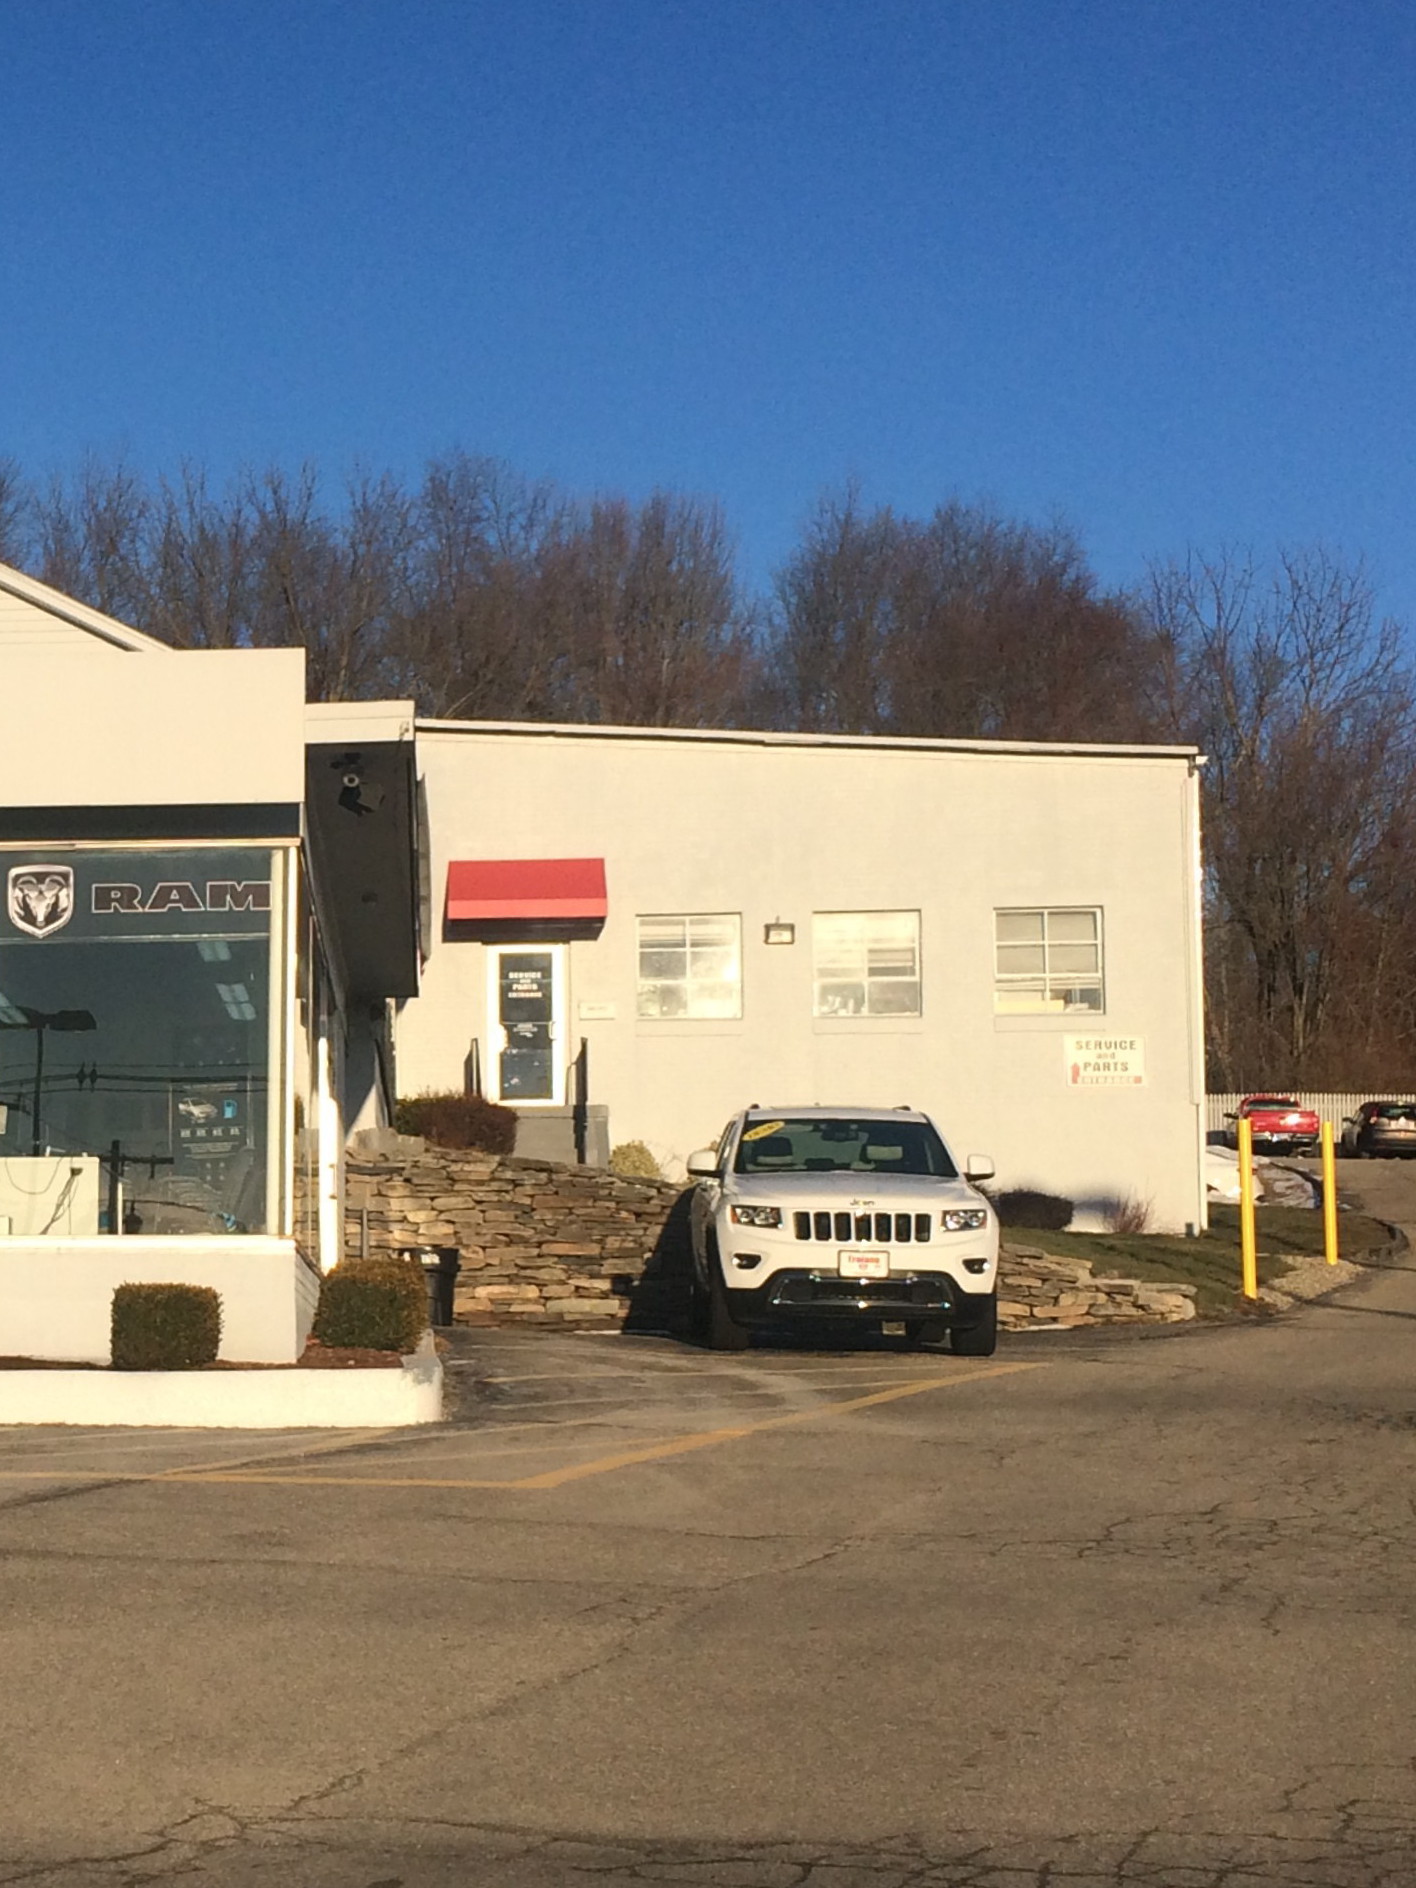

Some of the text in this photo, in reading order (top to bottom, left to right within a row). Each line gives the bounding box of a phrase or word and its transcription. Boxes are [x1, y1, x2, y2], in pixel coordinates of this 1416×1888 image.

[90, 880, 272, 913] RAM
[1075, 1040, 1137, 1050] SERVICE
[1096, 1051, 1116, 1060] and
[1083, 1061, 1129, 1072] PARTS
